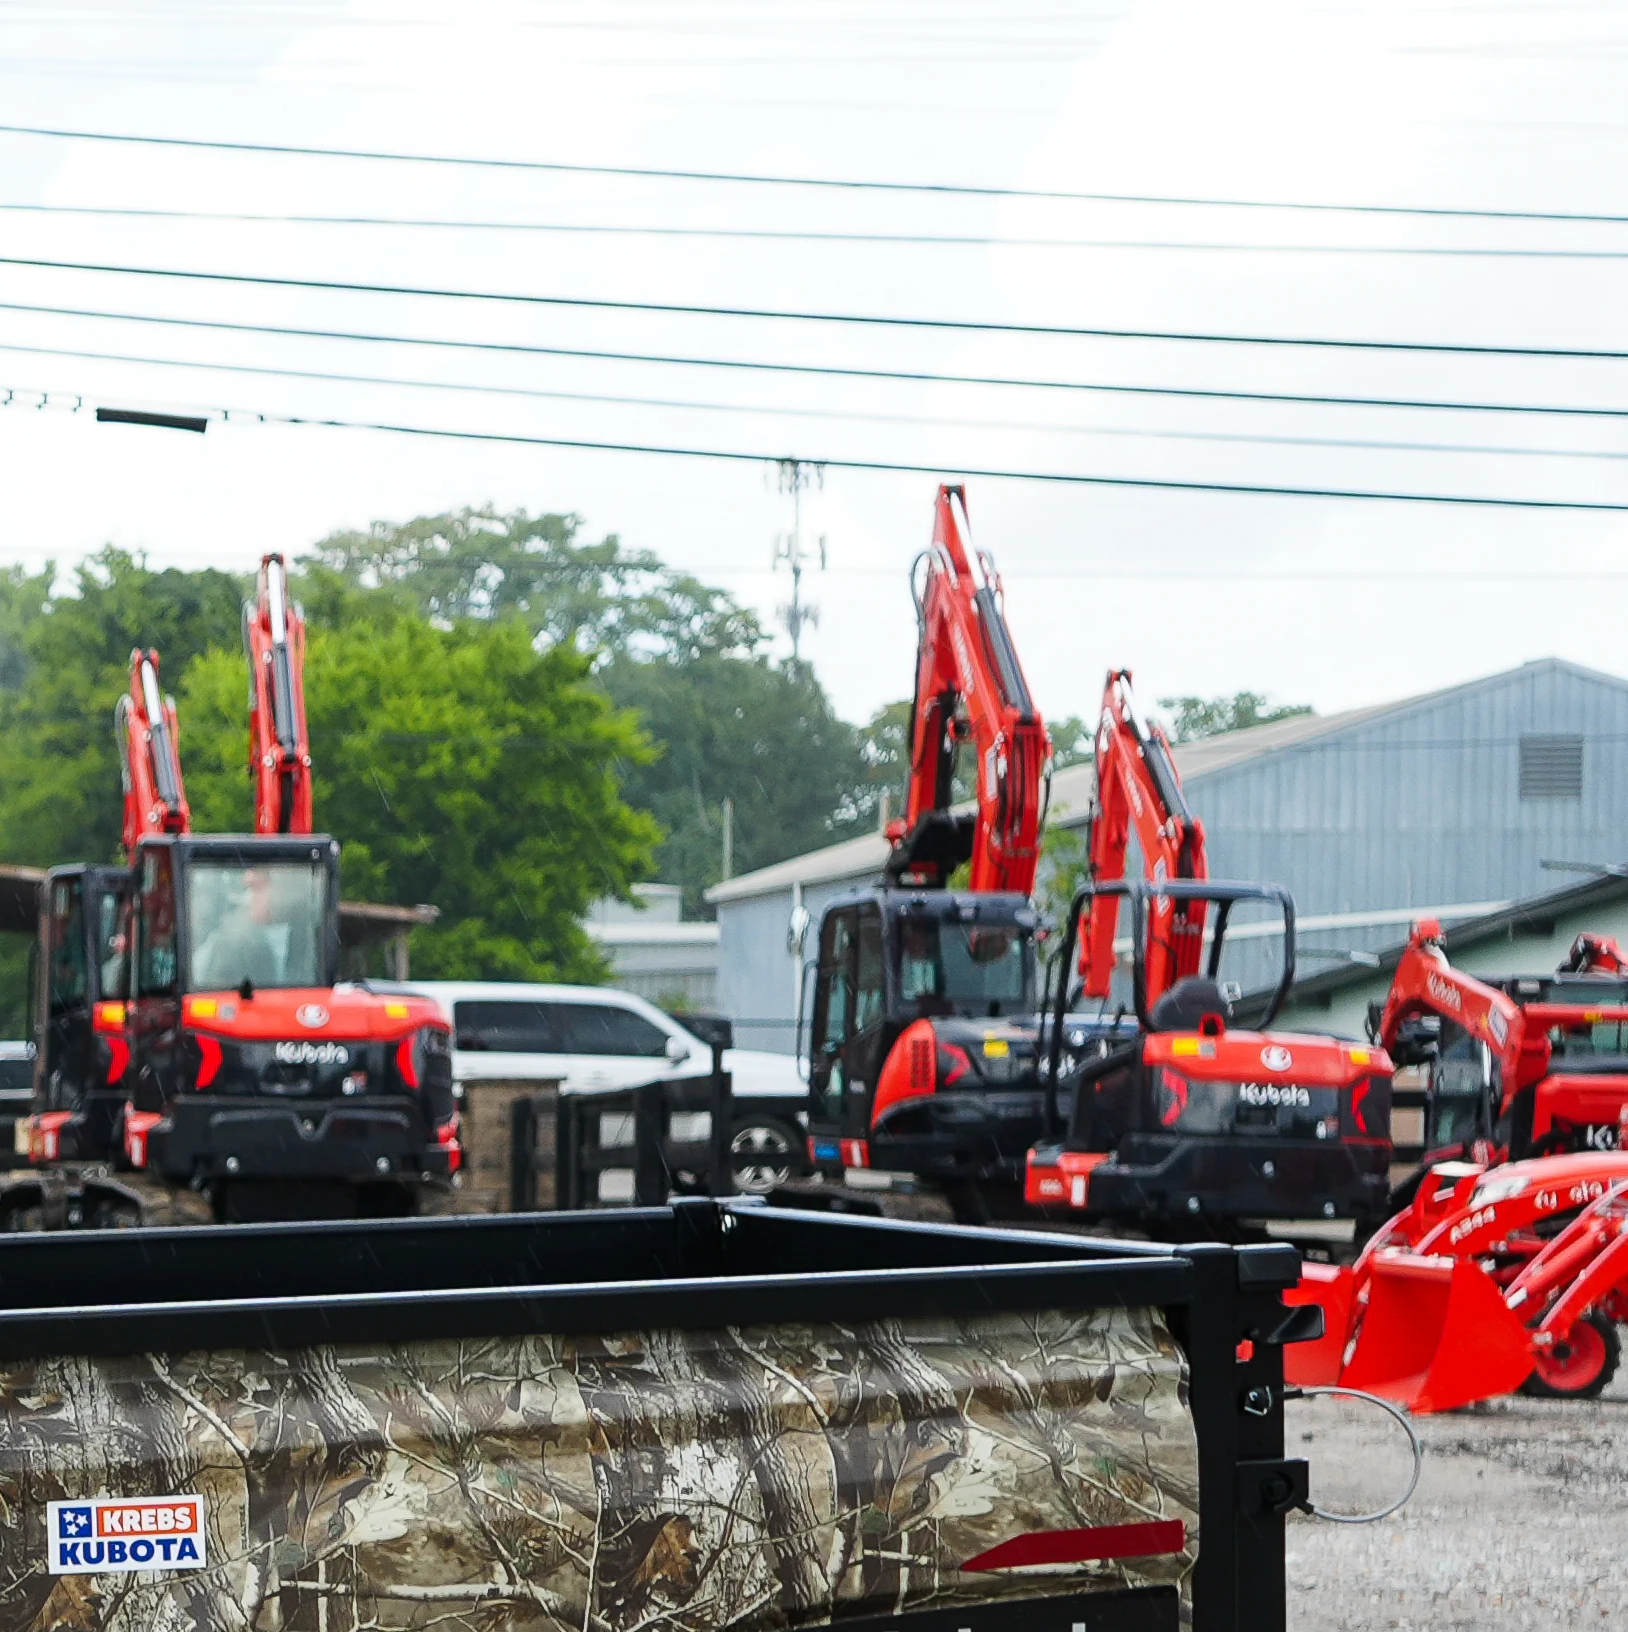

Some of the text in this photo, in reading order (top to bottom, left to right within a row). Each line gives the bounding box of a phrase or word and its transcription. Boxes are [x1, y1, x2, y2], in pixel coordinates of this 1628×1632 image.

[1240, 1083, 1310, 1106] Kubota
[103, 1507, 192, 1533] KREBS
[59, 1538, 199, 1566] KUBOTA
